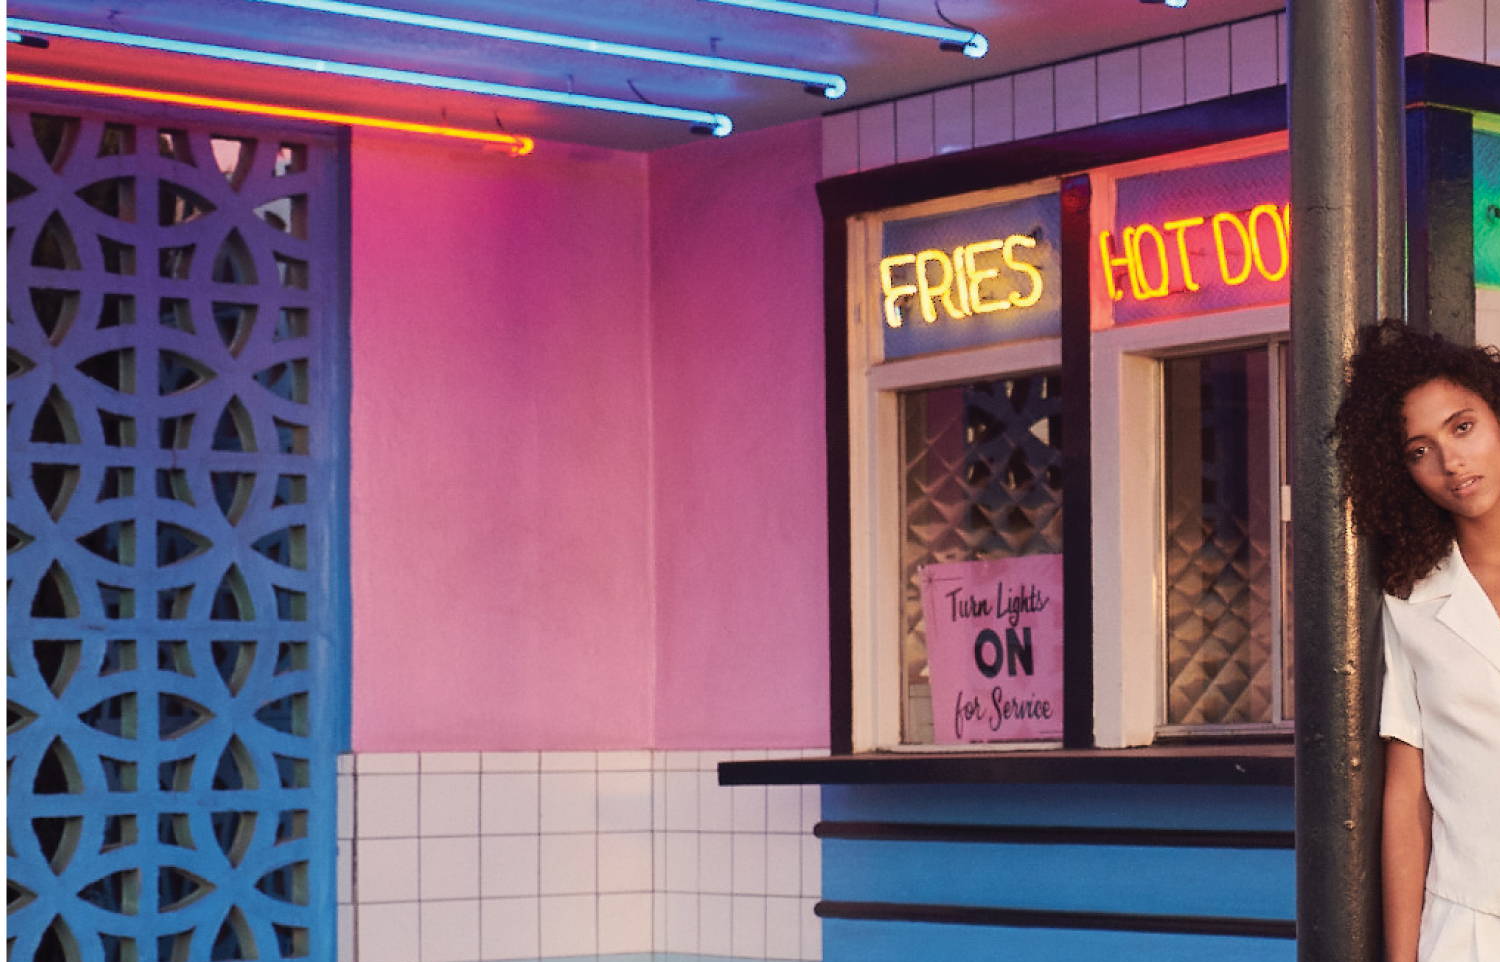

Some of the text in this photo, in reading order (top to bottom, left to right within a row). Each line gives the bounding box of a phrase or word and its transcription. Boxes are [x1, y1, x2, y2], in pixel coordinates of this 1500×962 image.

[1100, 203, 1291, 301] HOT DO
[880, 234, 1043, 328] FRIES
[945, 581, 1049, 627] Turn Lights
[975, 627, 1034, 678] ON
[954, 686, 1053, 739] for Service
